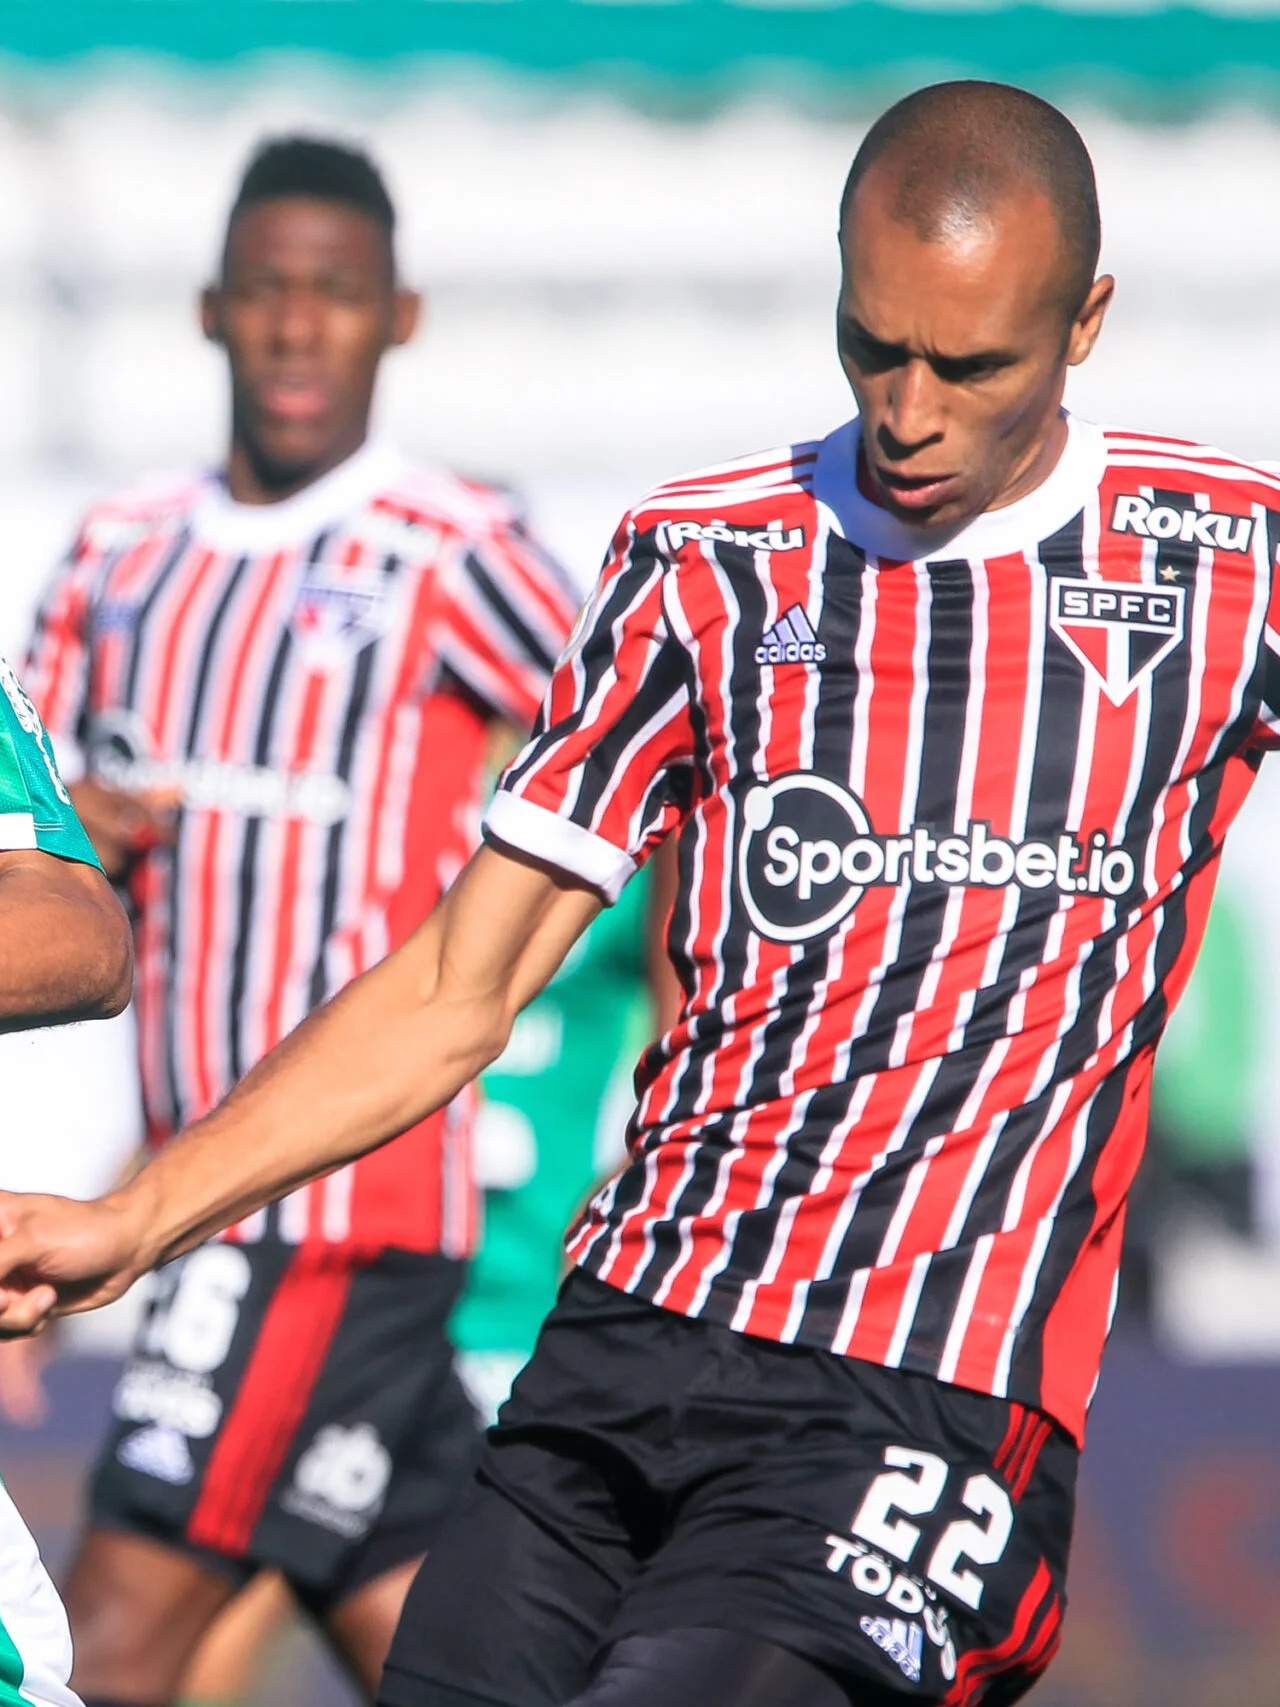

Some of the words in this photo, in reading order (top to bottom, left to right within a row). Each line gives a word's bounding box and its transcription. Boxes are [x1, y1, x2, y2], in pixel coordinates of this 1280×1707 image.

[667, 521, 805, 551] Roku
[1111, 494, 1253, 552] Roku
[1063, 590, 1171, 624] SPFC
[754, 642, 827, 665] adidas
[763, 822, 1135, 900] Sportsbet.io
[851, 1445, 1014, 1611] 22
